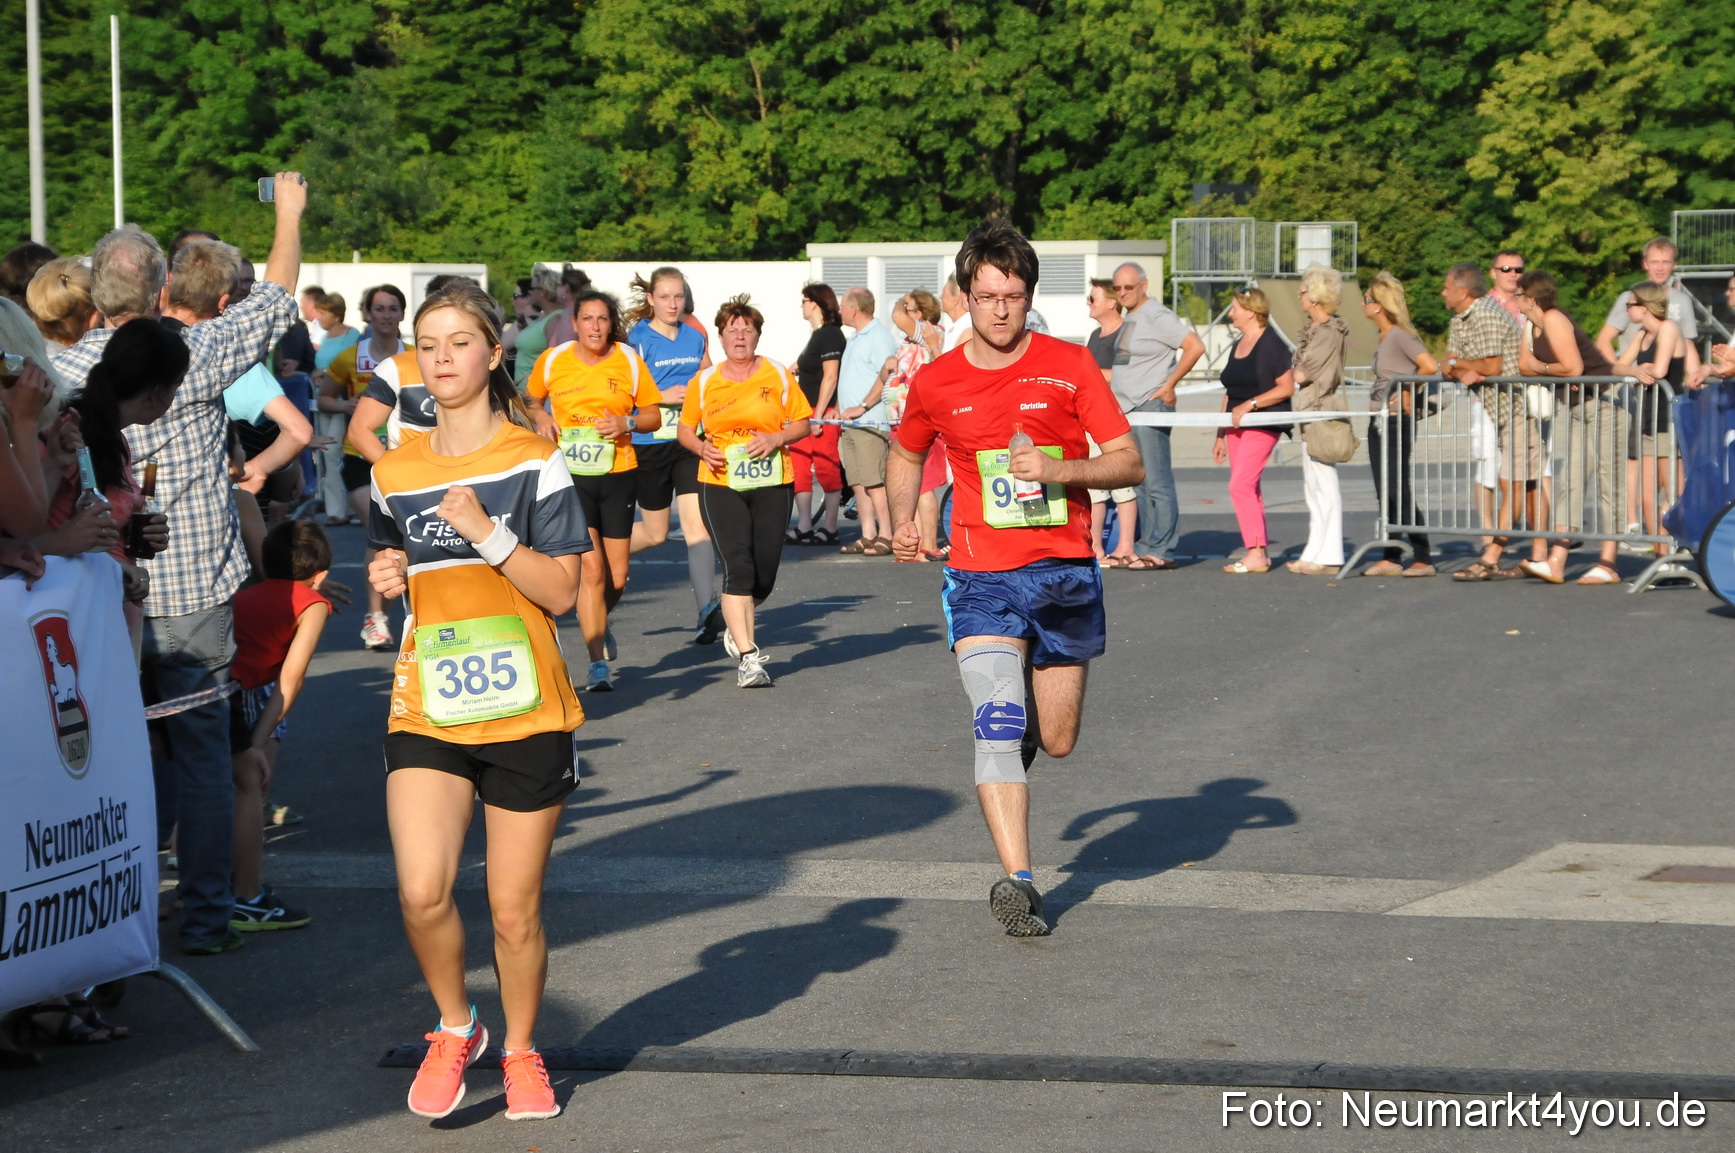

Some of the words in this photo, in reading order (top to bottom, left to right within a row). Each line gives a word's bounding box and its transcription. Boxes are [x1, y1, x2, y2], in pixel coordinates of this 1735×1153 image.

[1020, 401, 1047, 411] Christian
[565, 443, 605, 463] 467
[734, 459, 773, 480] 469
[435, 650, 518, 699] 385
[66, 737, 86, 763] 1628
[24, 796, 129, 873] Neumarkter
[0, 848, 142, 962] Lammsbräu
